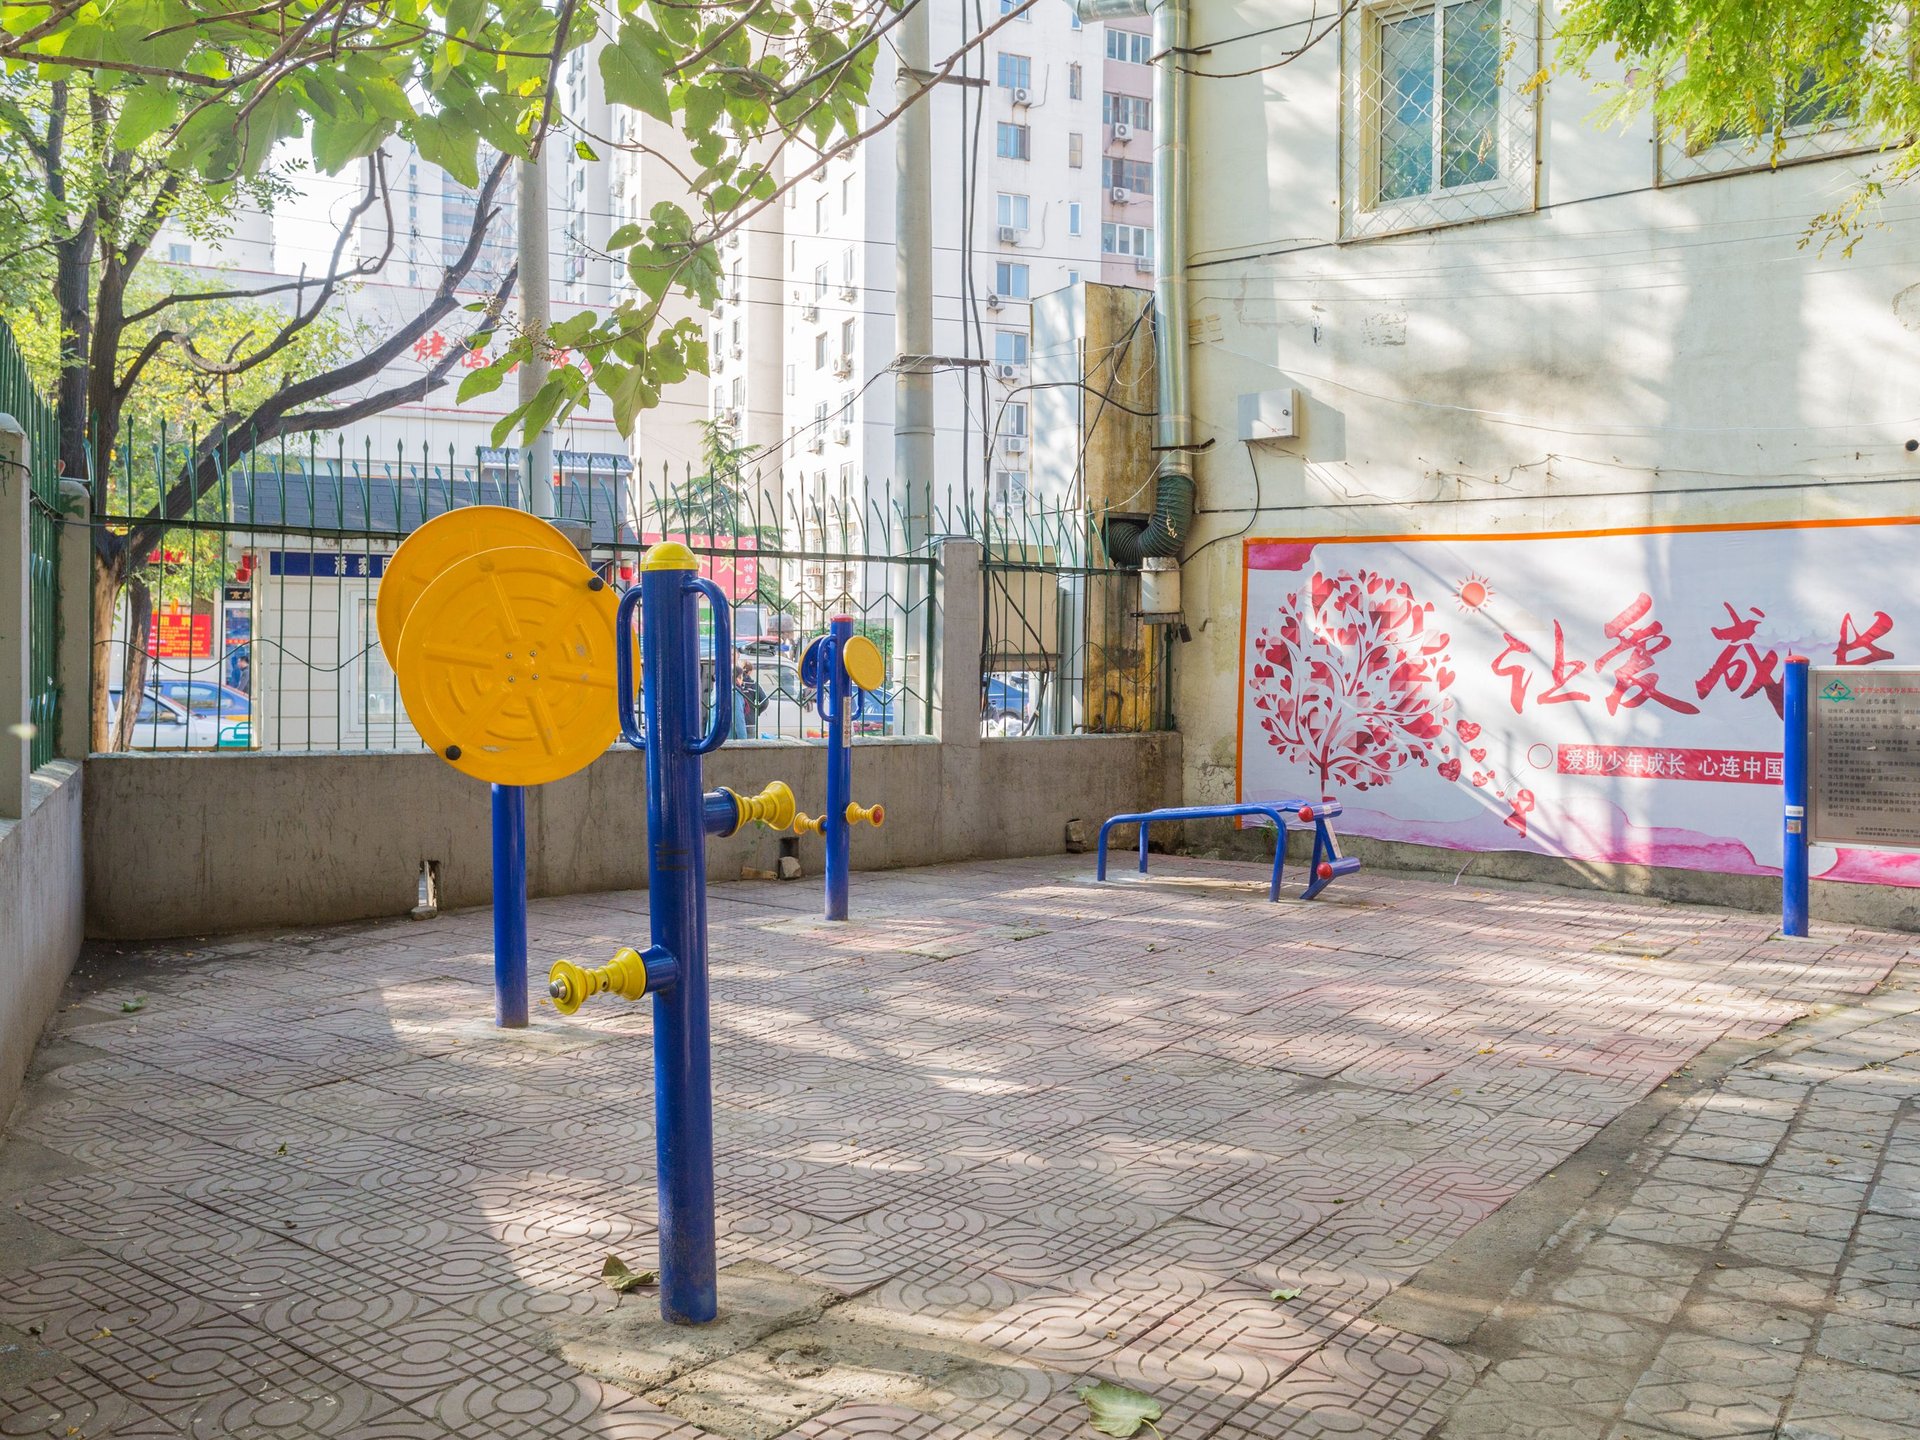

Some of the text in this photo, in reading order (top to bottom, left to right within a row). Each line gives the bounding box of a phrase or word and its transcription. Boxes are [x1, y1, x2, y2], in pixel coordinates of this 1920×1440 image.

[1565, 748, 1784, 781] 爱助少年成长 心连中国
